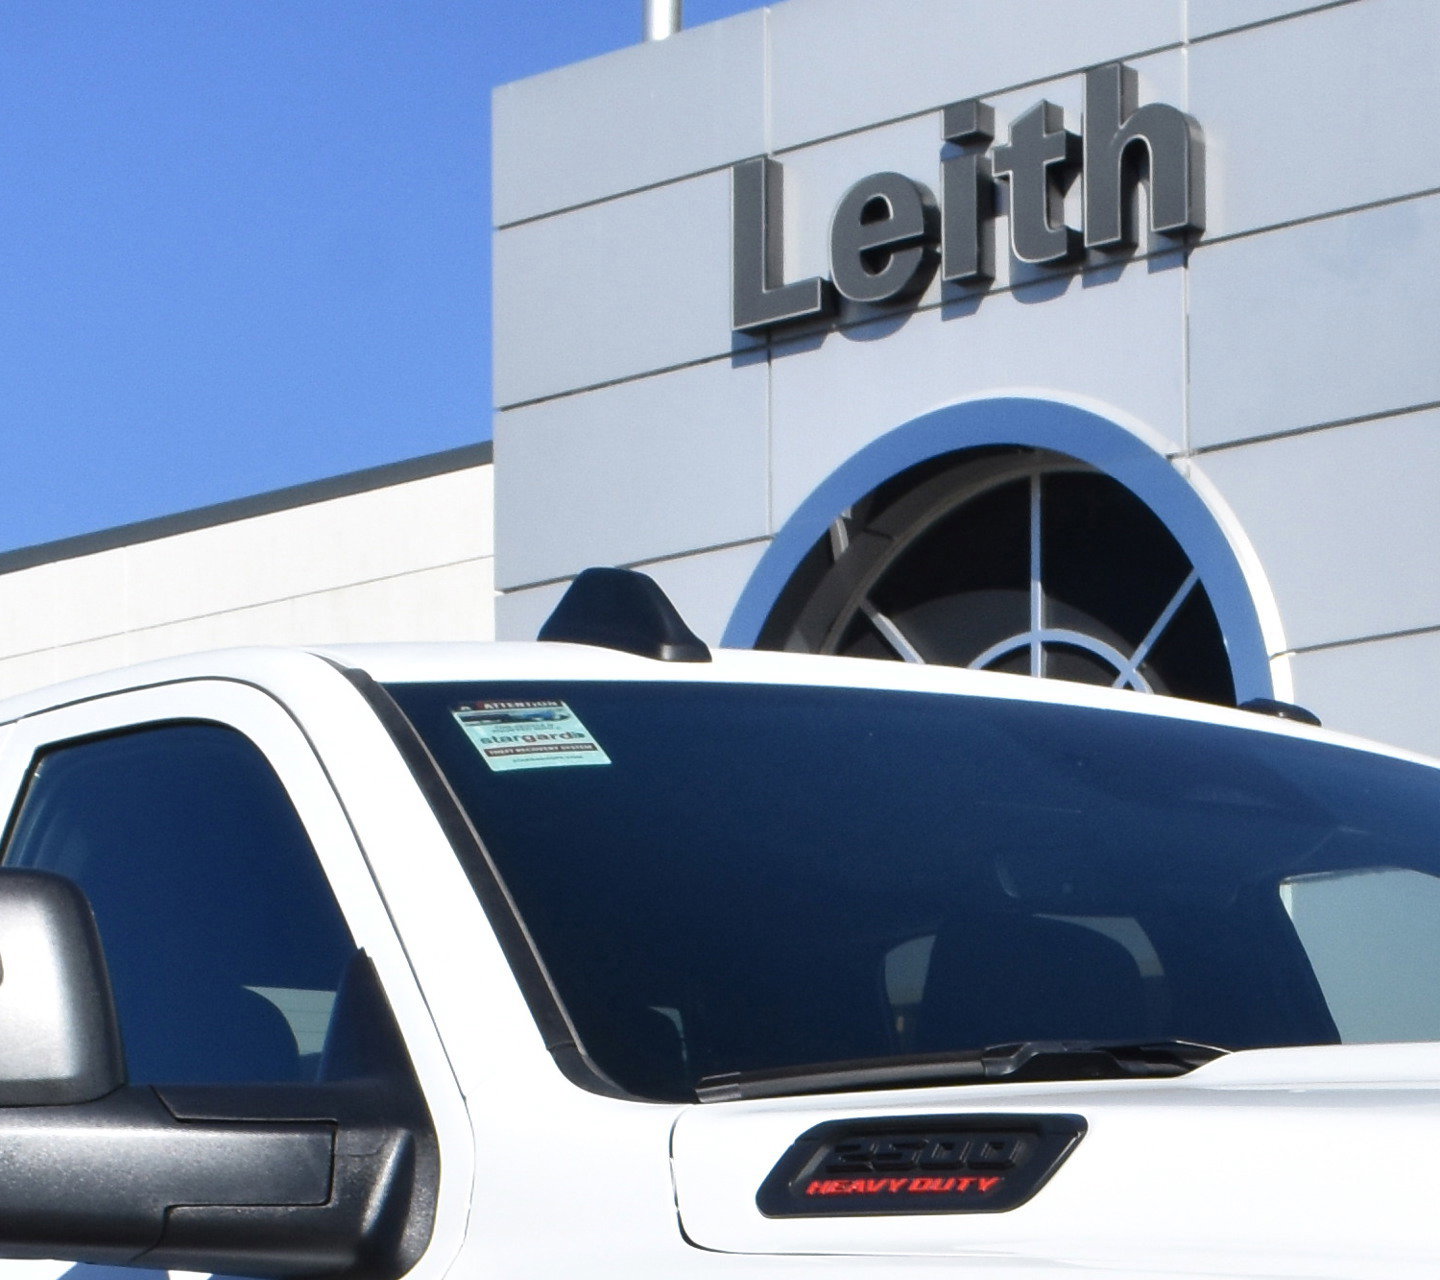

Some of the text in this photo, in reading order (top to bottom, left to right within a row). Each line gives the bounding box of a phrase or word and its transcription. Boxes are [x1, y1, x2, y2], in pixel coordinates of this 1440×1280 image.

[732, 62, 1206, 334] Leith
[806, 1176, 1001, 1195] HEAVY DUTY
